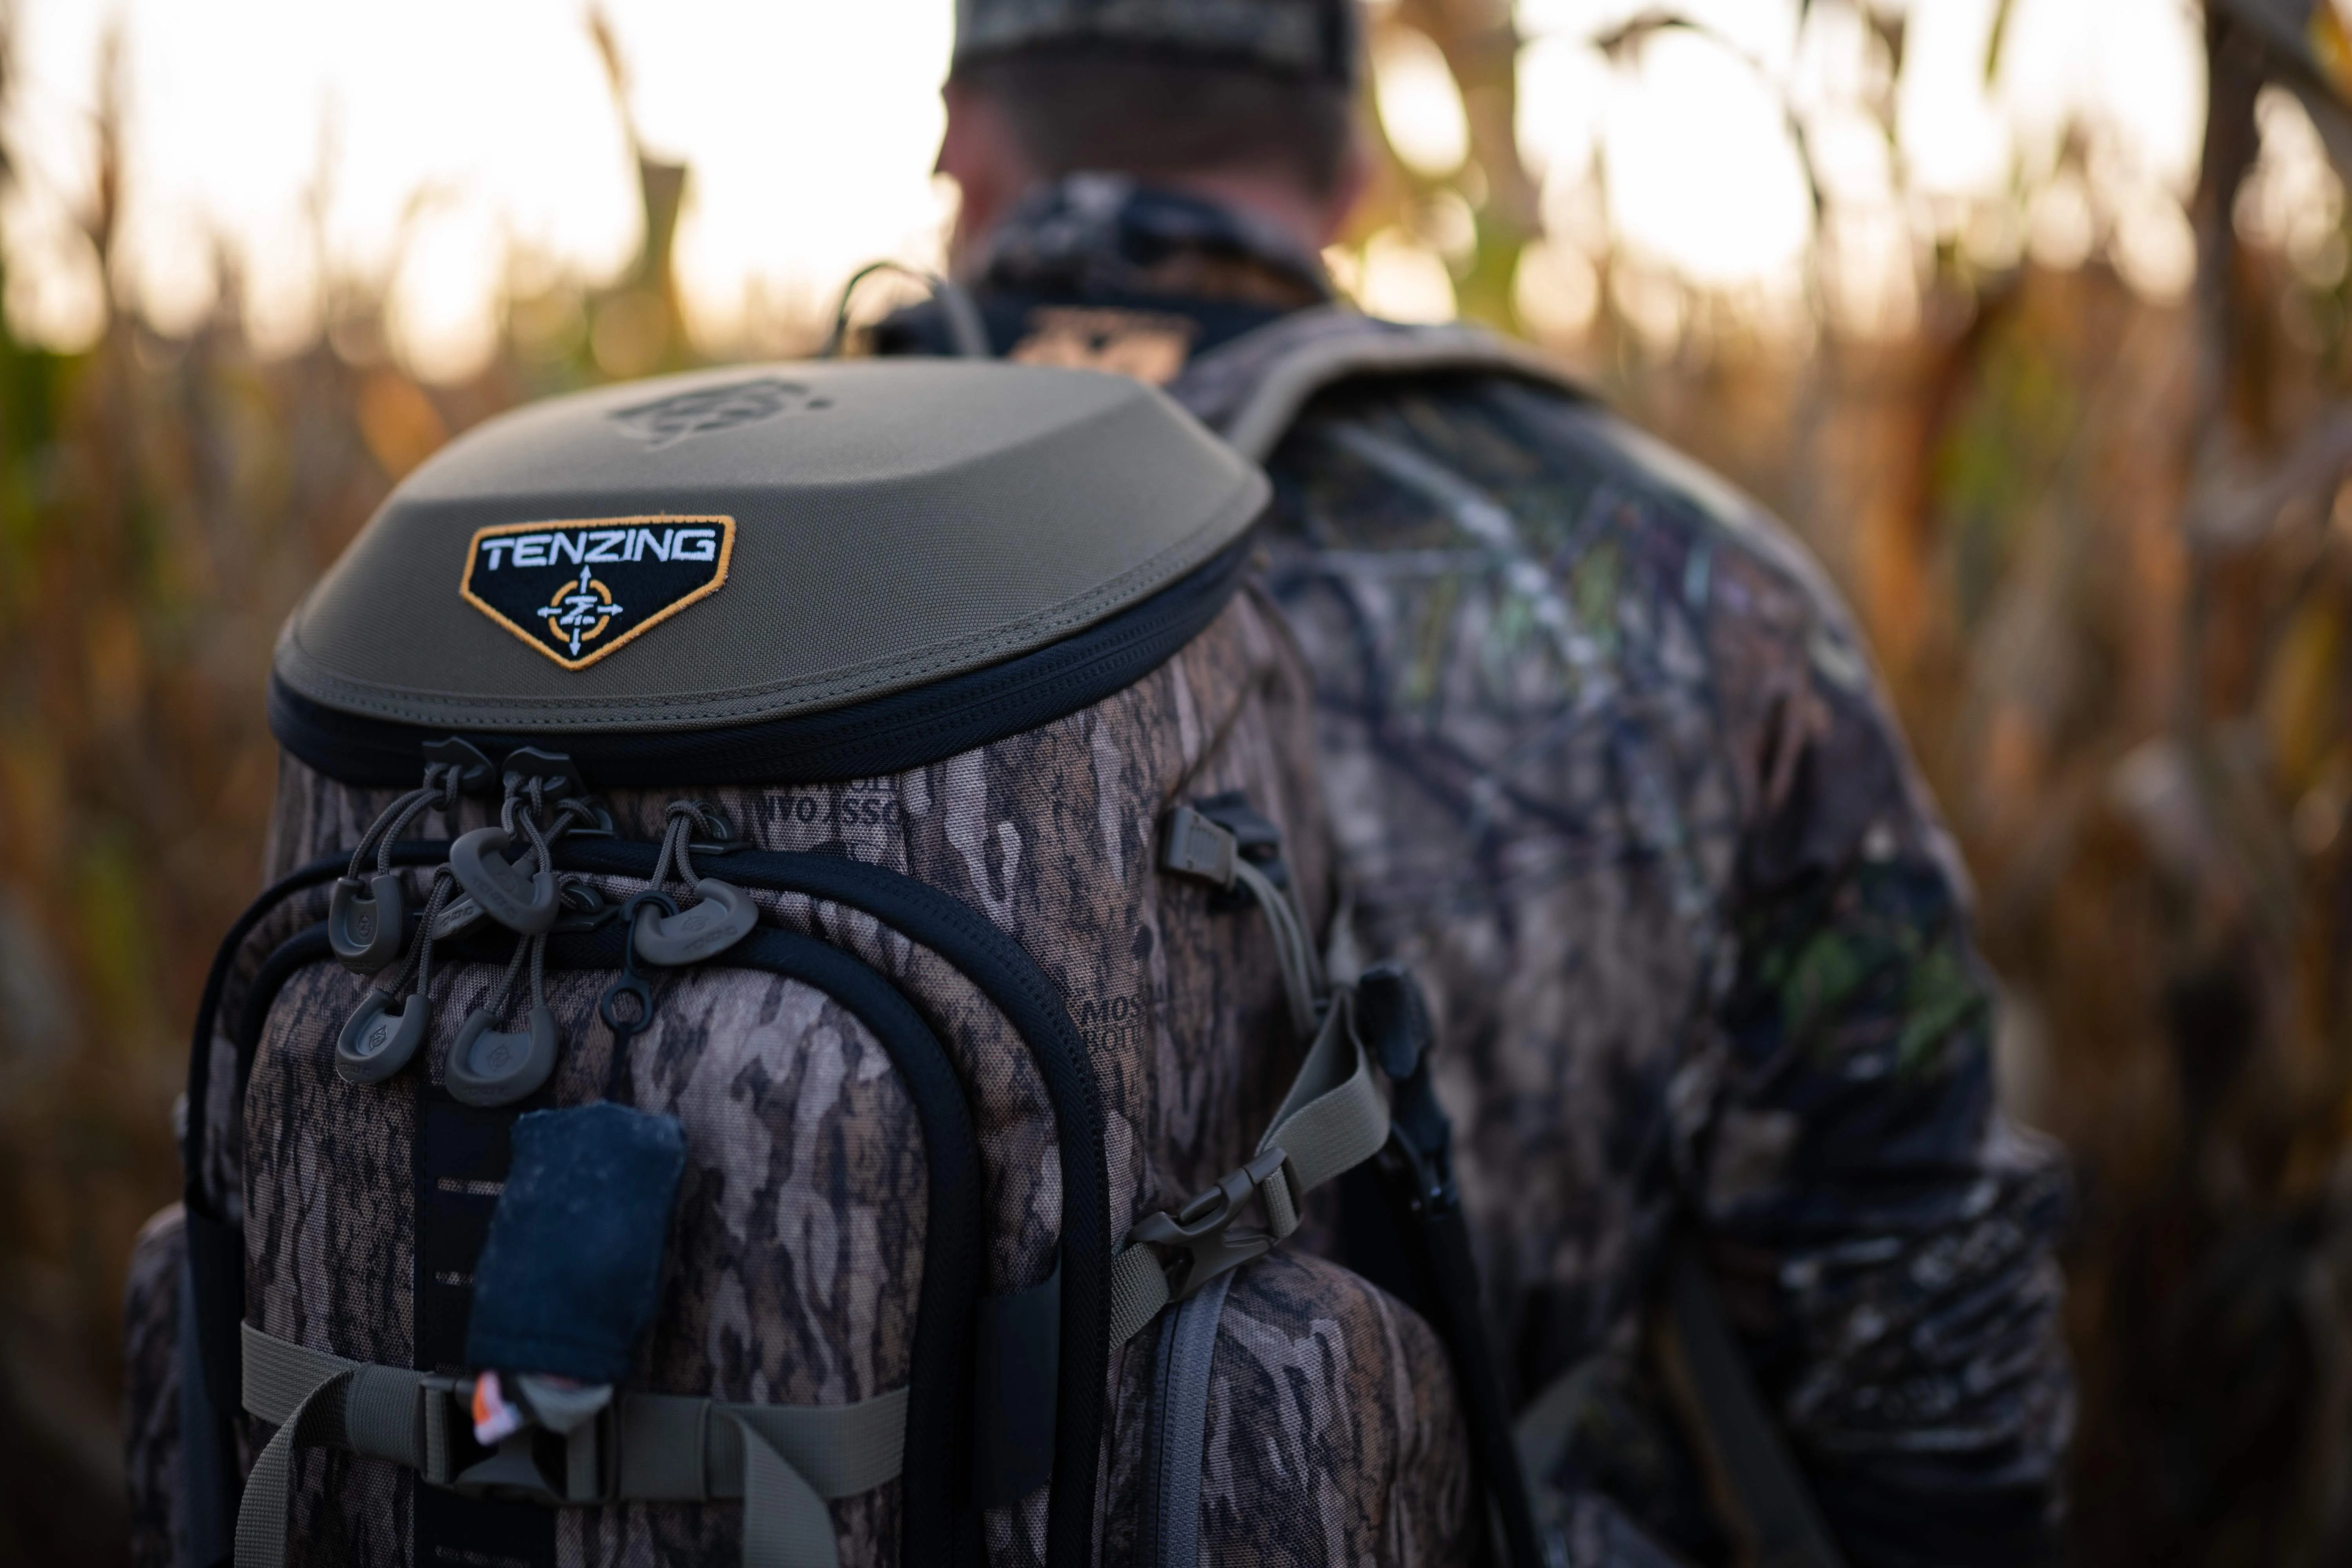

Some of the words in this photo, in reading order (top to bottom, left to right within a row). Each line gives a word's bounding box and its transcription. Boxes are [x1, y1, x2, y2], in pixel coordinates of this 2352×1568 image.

[481, 528, 715, 571] TENZING
[822, 798, 901, 826] OSSY
[1080, 993, 1142, 1026] MOS
